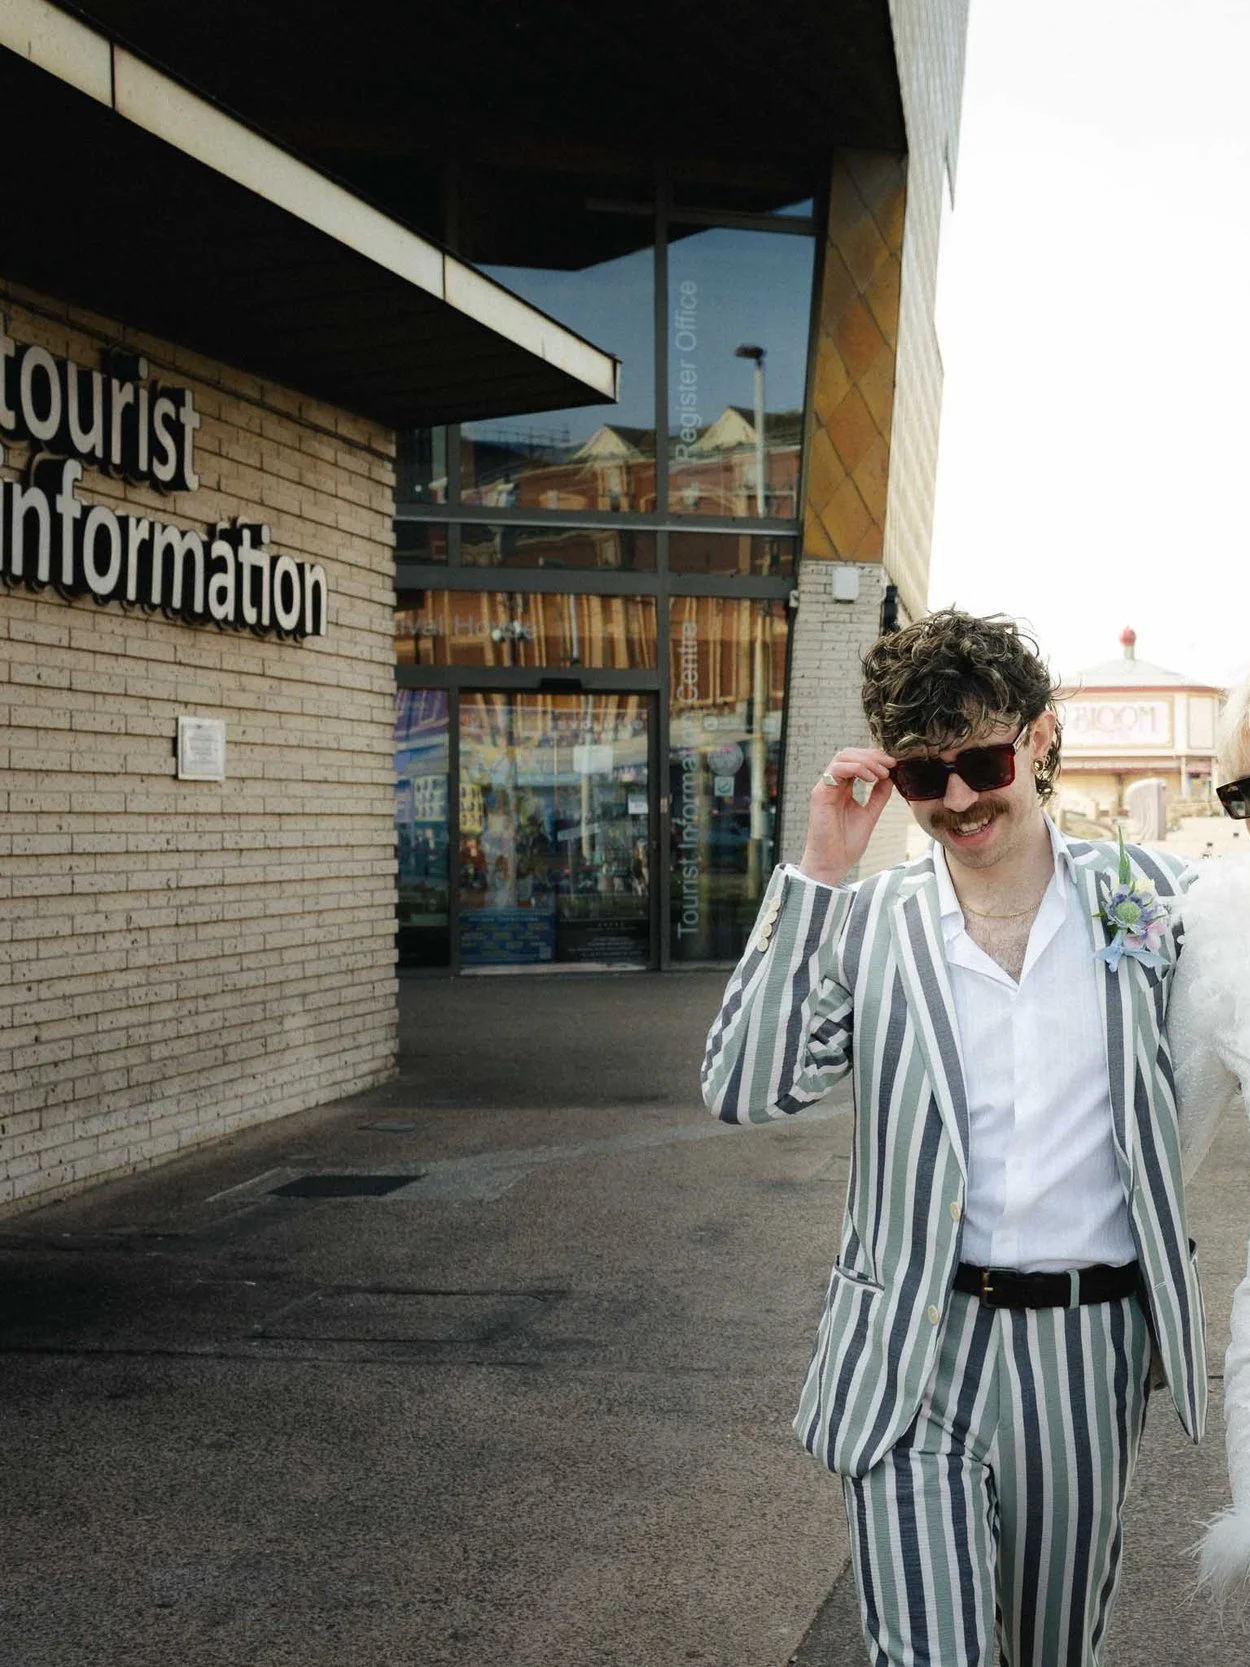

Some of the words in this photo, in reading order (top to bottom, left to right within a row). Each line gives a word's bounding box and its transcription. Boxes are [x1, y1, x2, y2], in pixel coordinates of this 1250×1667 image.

[675, 281, 697, 352] Office
[674, 359, 702, 461] Register
[0, 441, 328, 637] nformation
[676, 857, 698, 940] Tourist
